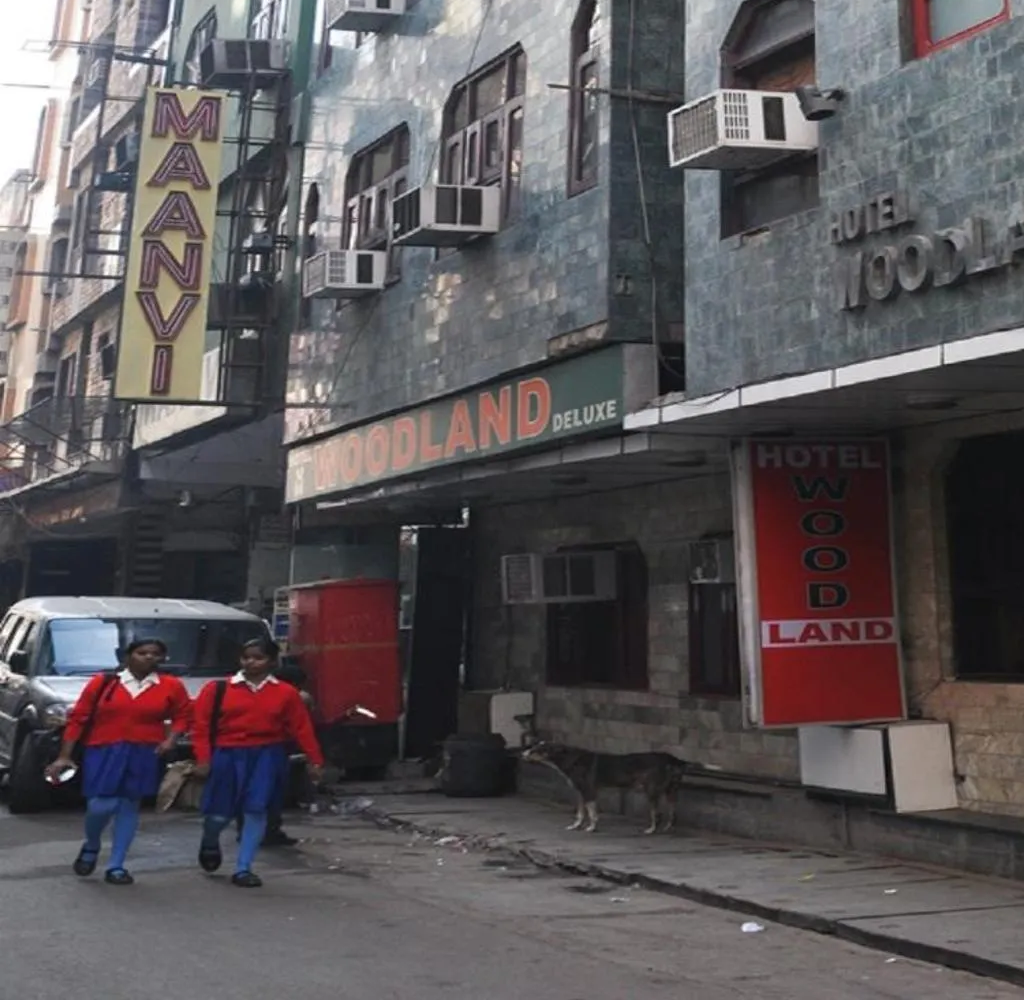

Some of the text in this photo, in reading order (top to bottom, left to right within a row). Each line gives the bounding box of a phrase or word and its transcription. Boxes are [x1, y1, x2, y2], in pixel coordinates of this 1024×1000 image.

[135, 91, 222, 397] MAANVI
[312, 374, 550, 492] WOODLAND
[552, 400, 617, 433] DELUXE
[756, 444, 884, 470] HOTEL
[792, 473, 850, 612] WOOD
[767, 621, 894, 645] LAND
